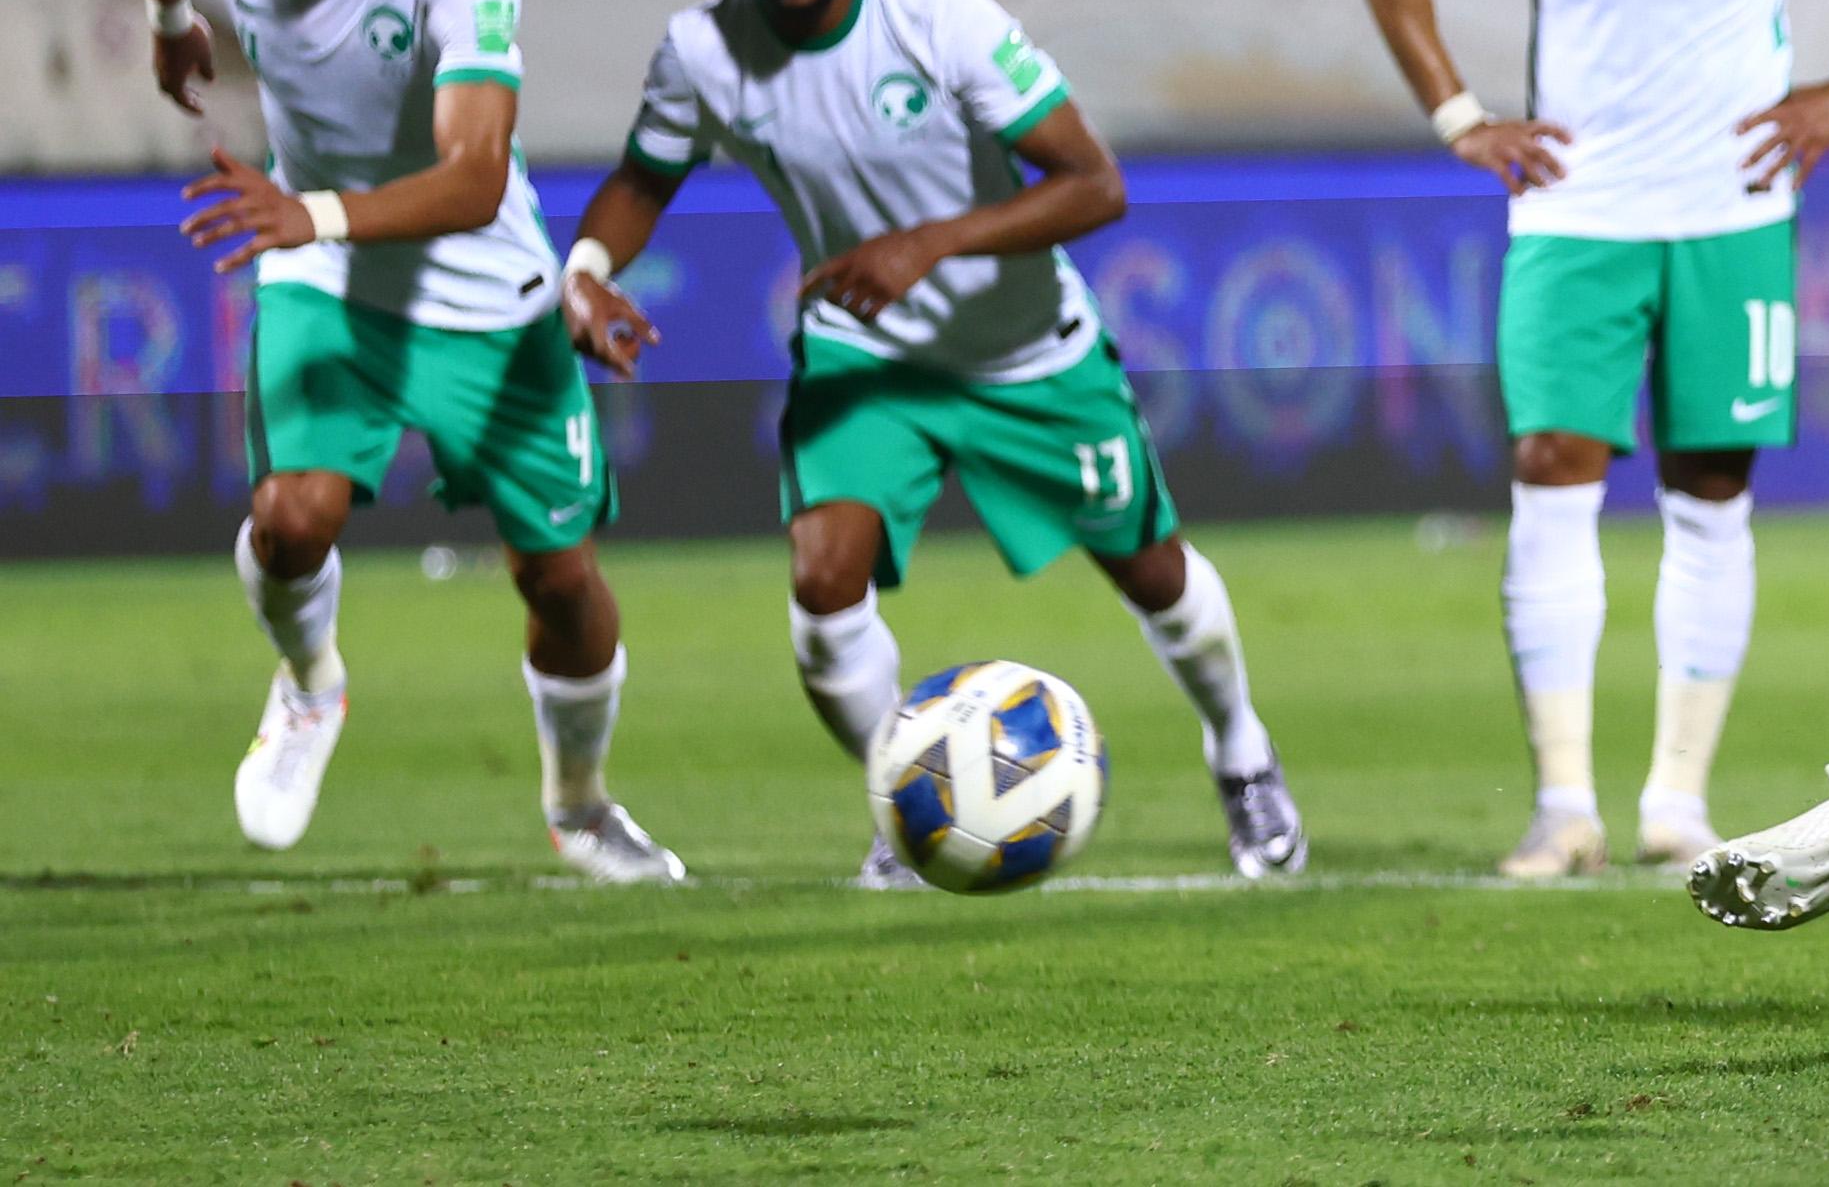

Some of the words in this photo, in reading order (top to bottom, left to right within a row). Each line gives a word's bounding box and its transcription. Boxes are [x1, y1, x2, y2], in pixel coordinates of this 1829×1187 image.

[1743, 298, 1796, 390] 10
[565, 412, 593, 488] 4
[1072, 434, 1133, 511] 13
